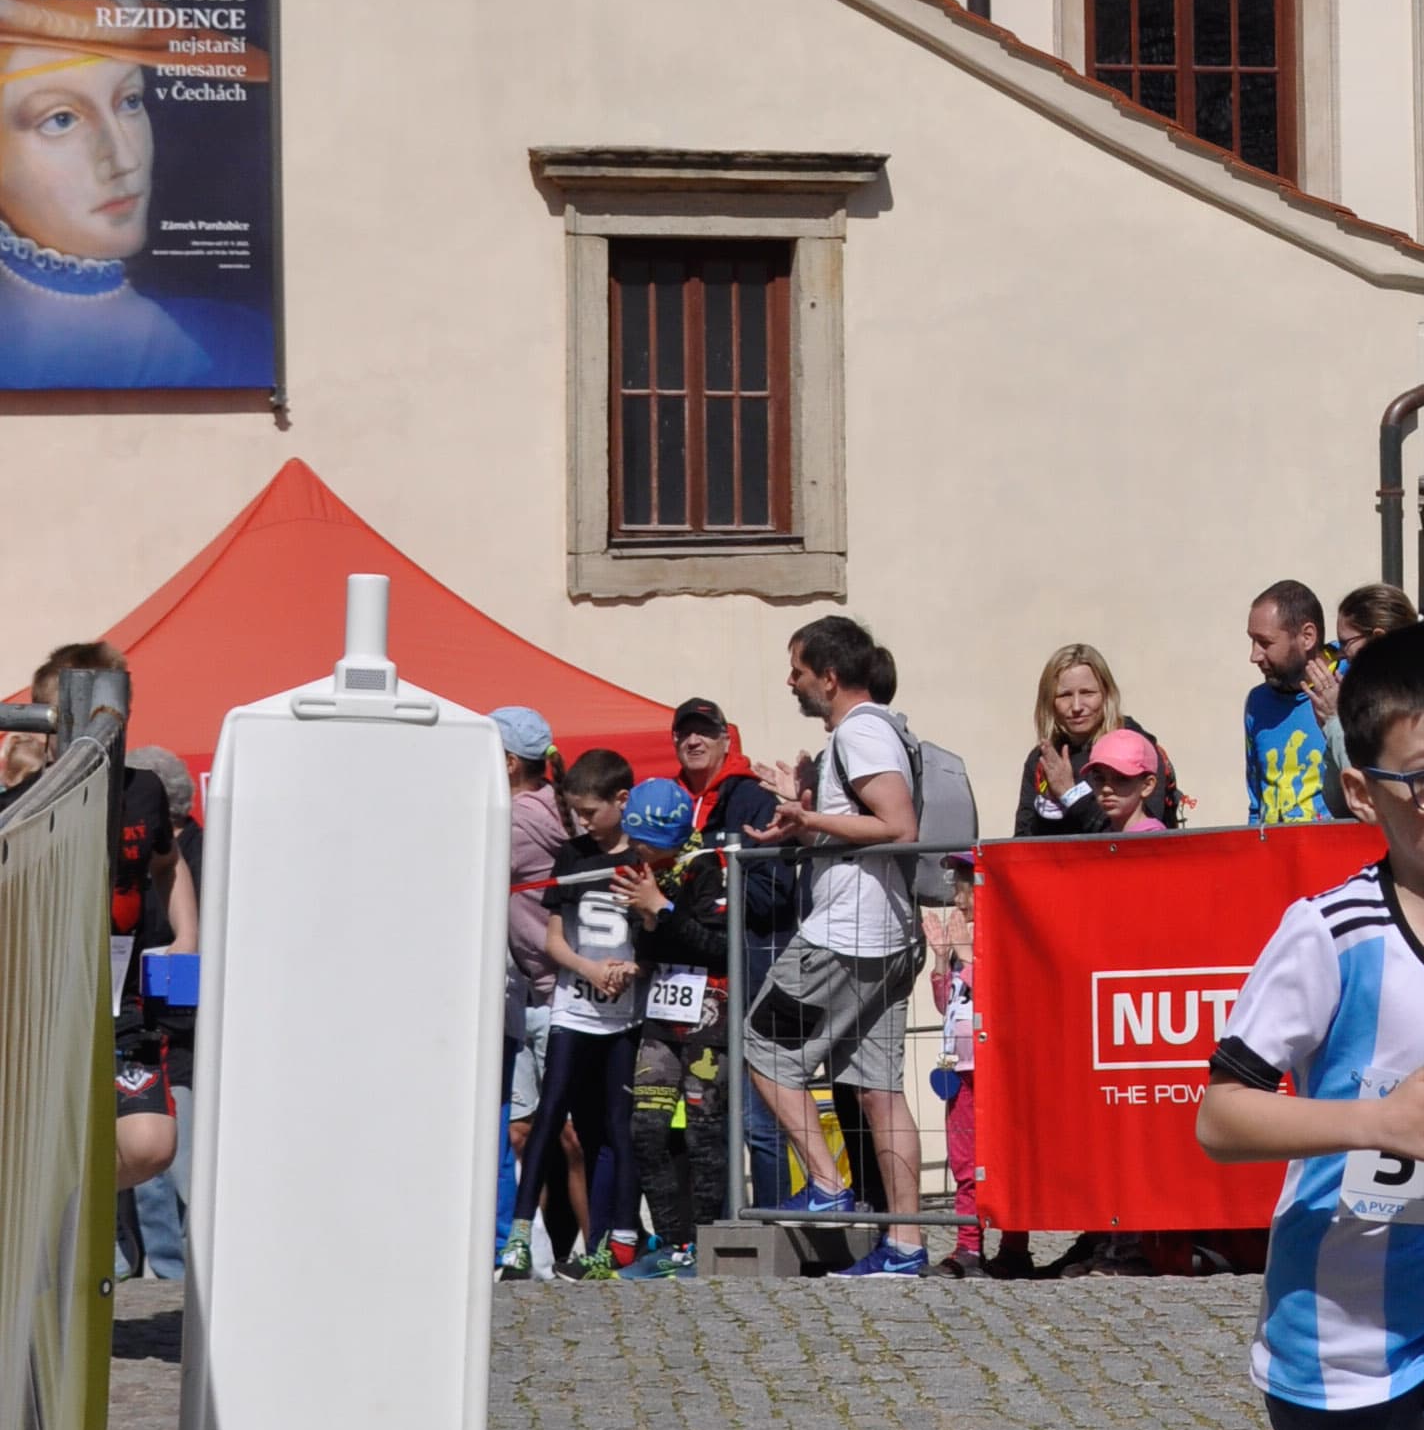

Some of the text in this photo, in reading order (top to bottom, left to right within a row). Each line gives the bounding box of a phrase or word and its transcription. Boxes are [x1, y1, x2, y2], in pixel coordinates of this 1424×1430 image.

[95, 6, 247, 29] REZIDENCE
[169, 36, 246, 56] nejstarší
[156, 63, 248, 78] renesance
[155, 80, 248, 101] v Čechách
[652, 982, 694, 1007] 2138
[1100, 1085, 1147, 1105] THE
